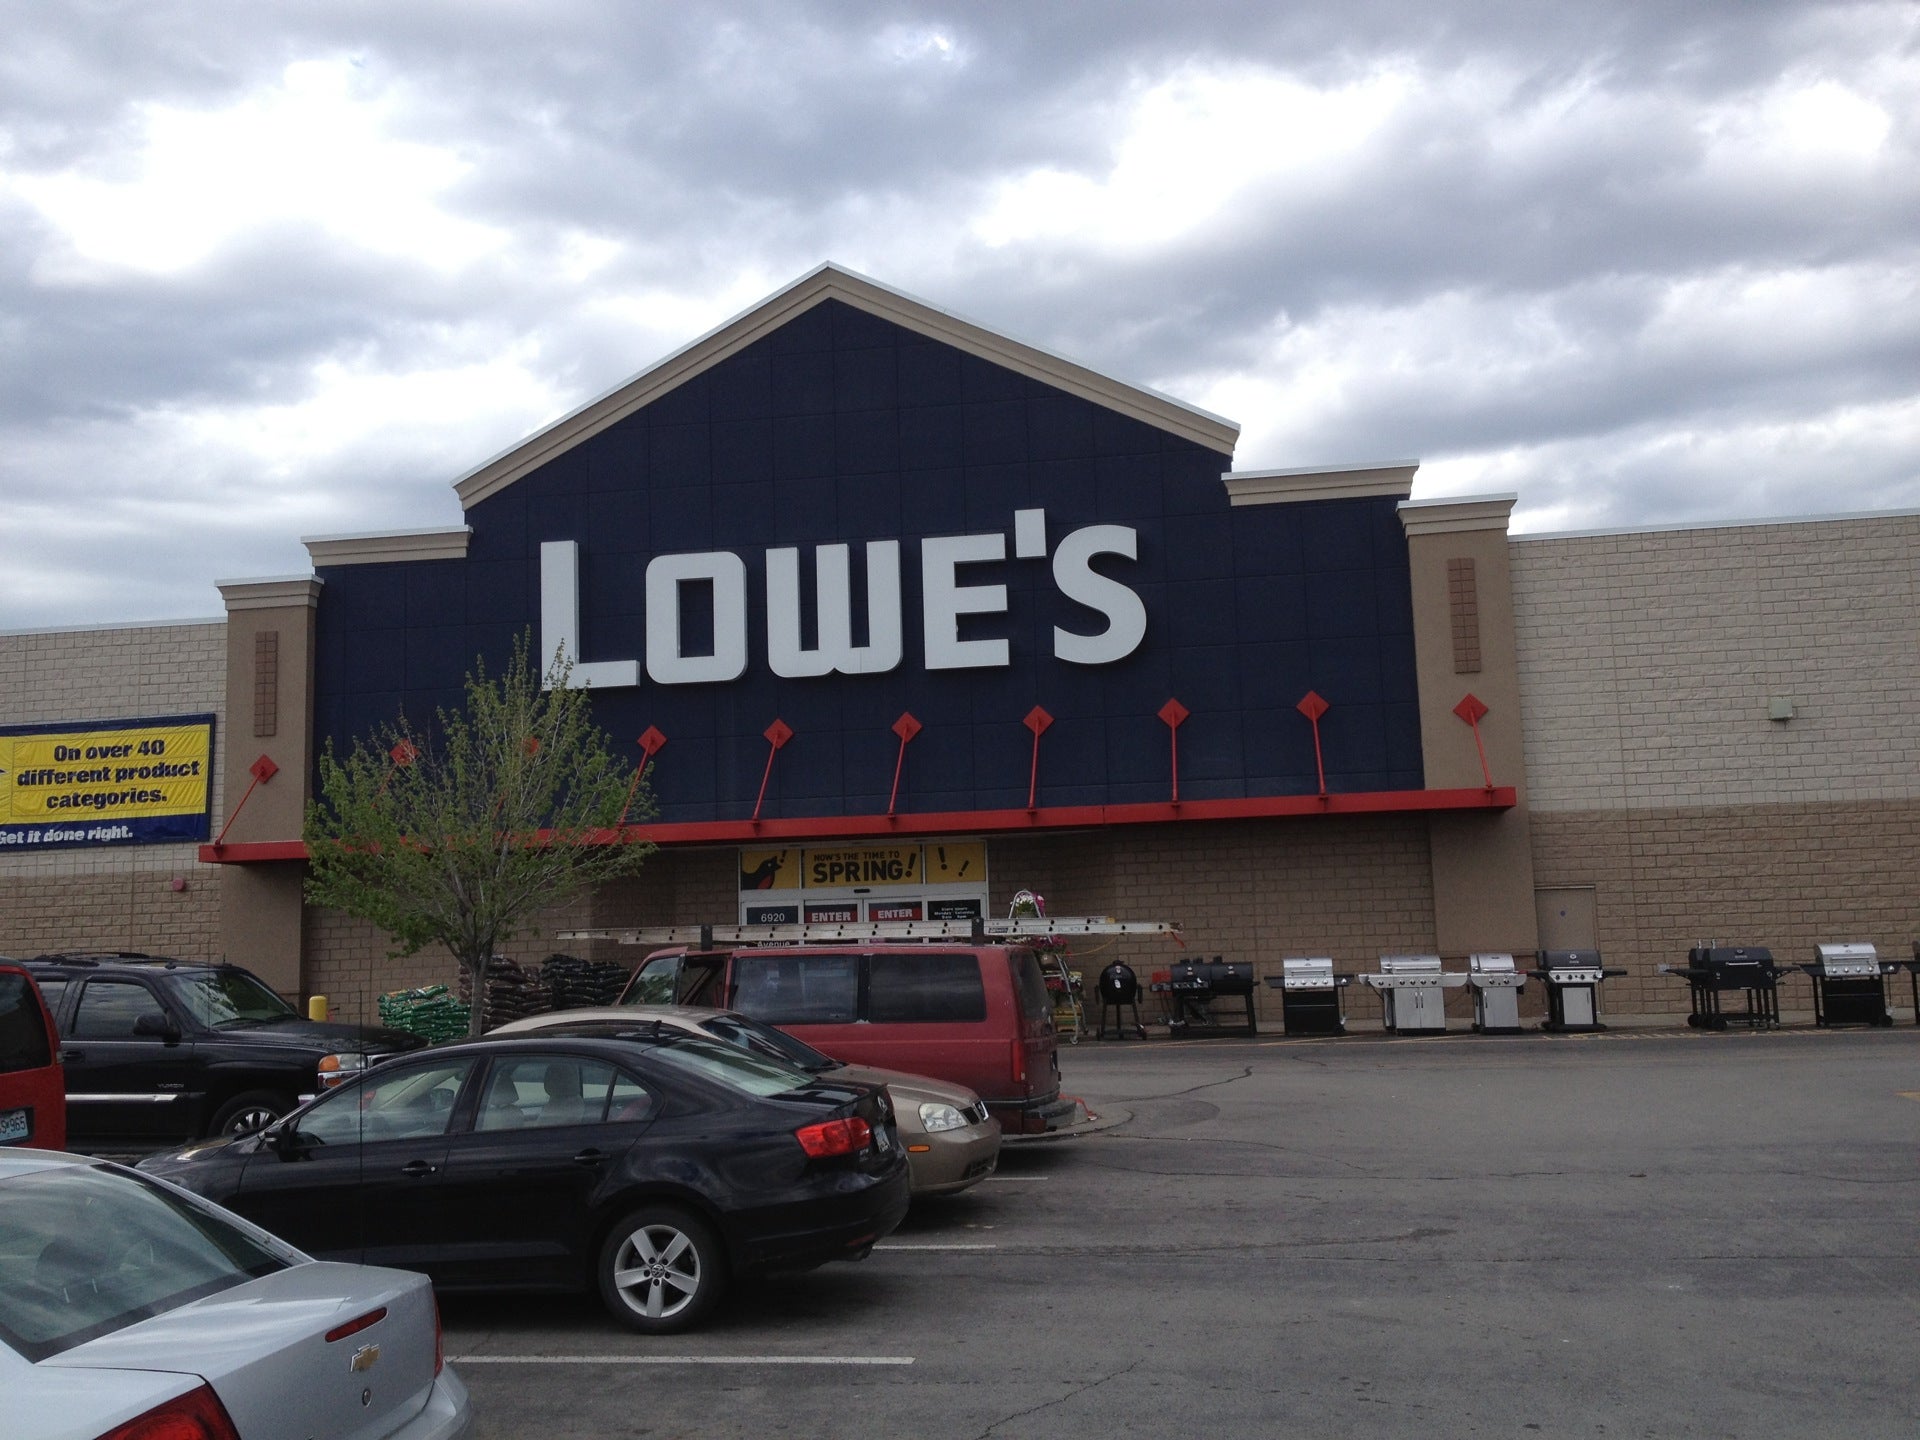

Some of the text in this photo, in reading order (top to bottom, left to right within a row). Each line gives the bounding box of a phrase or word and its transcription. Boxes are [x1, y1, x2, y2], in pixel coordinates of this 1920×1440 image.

[540, 507, 1147, 691] LOWE'S
[54, 739, 165, 762] On over 40
[17, 761, 200, 786] different product
[46, 788, 167, 809] categories.
[27, 830, 41, 843] it
[43, 829, 85, 842] done
[87, 825, 133, 841] right.
[862, 851, 885, 859] TIME
[888, 850, 900, 858] TO
[813, 852, 917, 883] SPRING!
[761, 913, 785, 922] 6920
[811, 911, 851, 922] ENTER
[877, 908, 913, 919] ENTER
